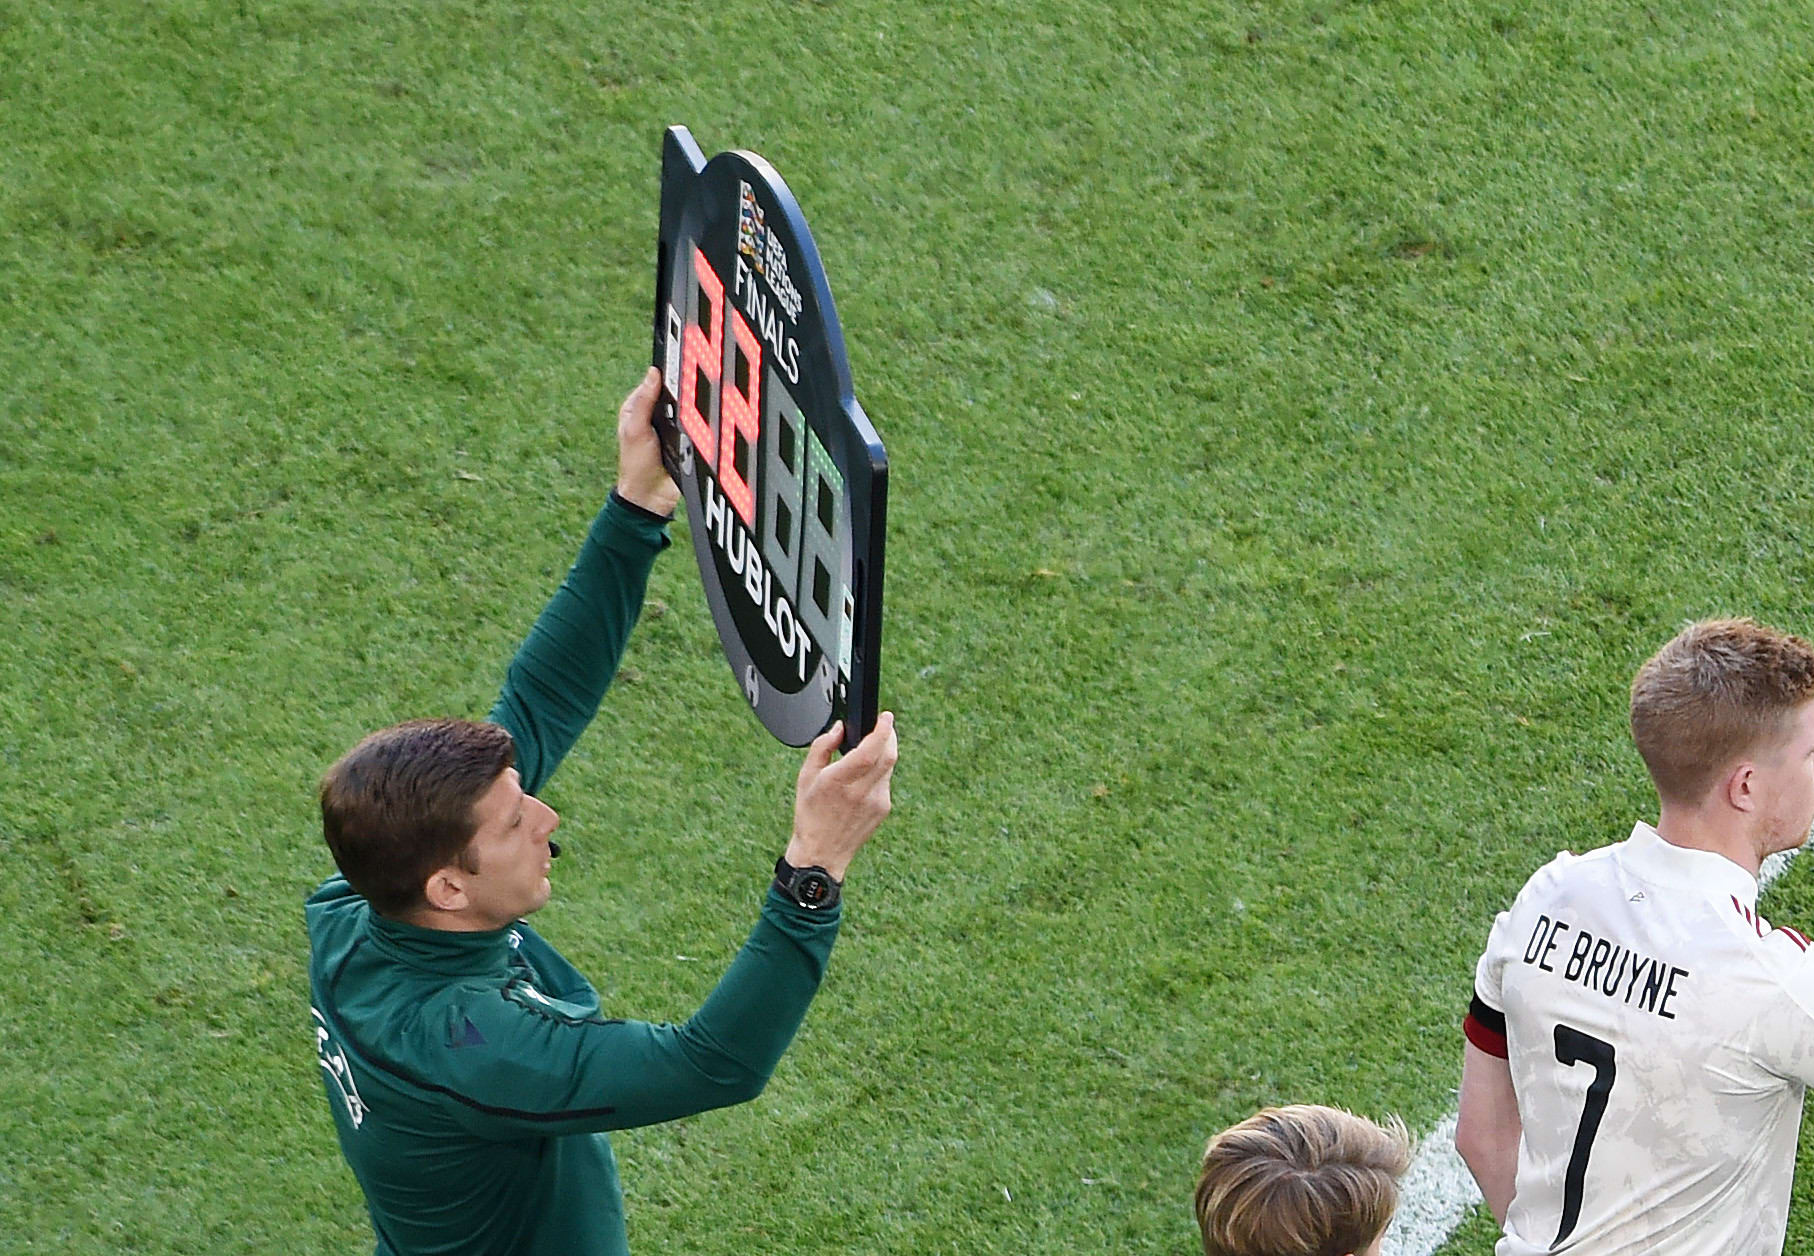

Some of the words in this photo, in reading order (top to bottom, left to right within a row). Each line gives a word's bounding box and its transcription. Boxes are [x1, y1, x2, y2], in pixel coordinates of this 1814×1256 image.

[765, 262, 797, 326] LEAGUE
[766, 245, 802, 313] NATIONS
[767, 226, 788, 272] UEFA
[735, 253, 799, 384] FINALS
[680, 247, 761, 528] 22
[706, 476, 811, 682] HUBLOT
[1523, 915, 1569, 973] DE
[1564, 931, 1689, 1020] BRUYNE
[1549, 1023, 1617, 1252] 7
